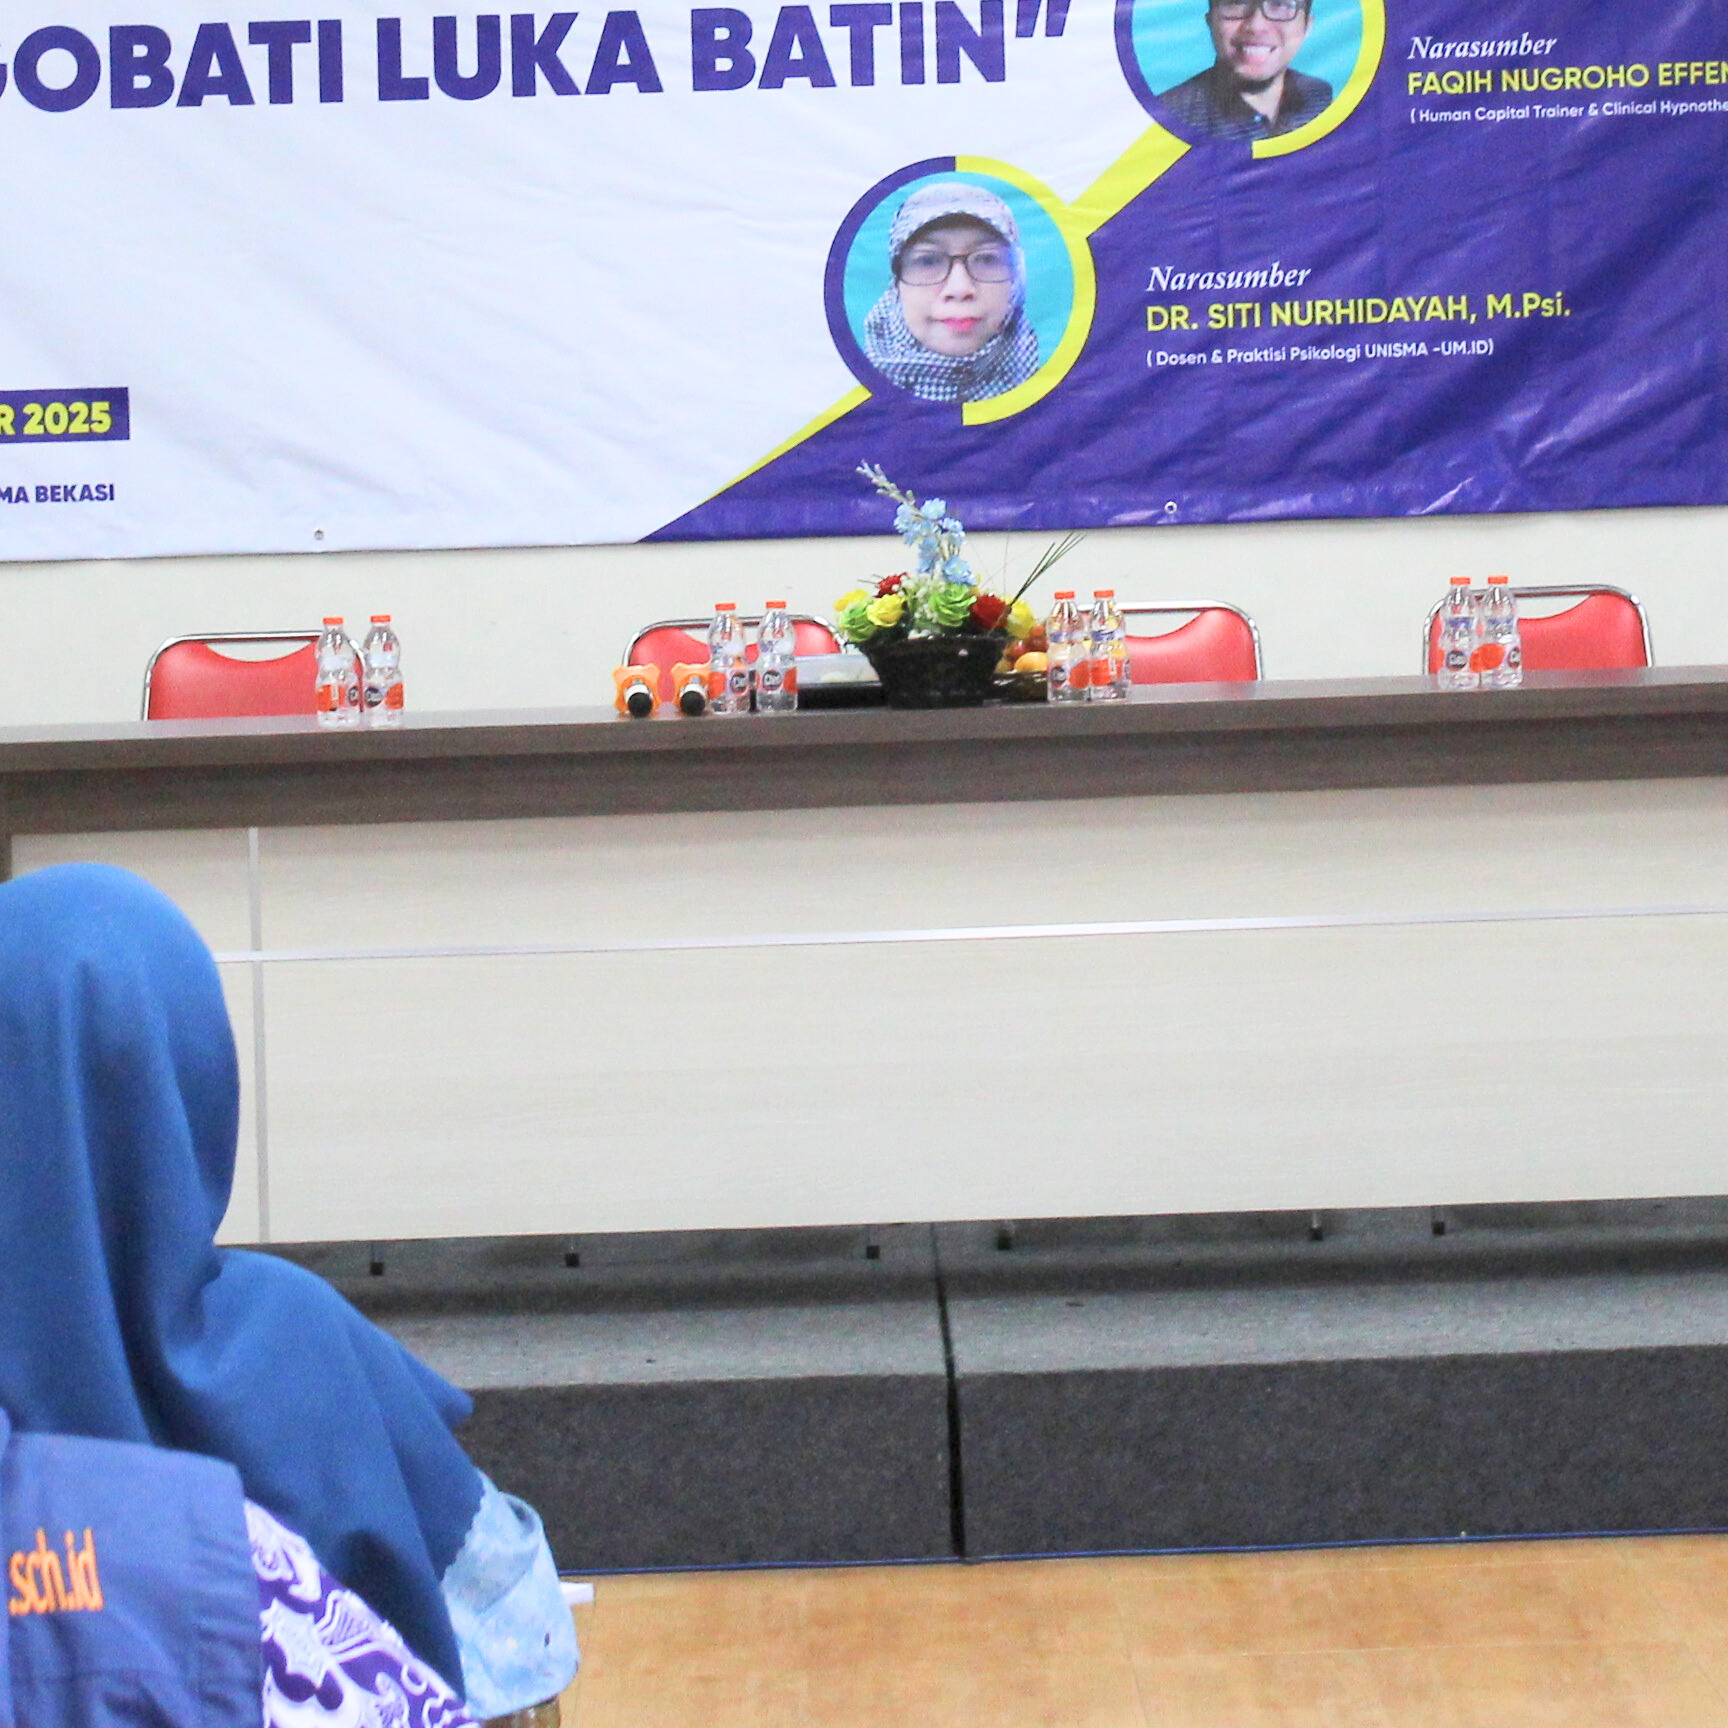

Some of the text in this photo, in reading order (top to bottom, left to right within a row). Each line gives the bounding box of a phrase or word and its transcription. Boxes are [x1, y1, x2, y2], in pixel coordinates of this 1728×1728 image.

[377, 11, 664, 101] LUKA
[1408, 36, 1557, 60] Narasumber
[1408, 71, 1493, 96] FAQIH
[1502, 65, 1649, 93] NUGROHO
[1420, 109, 1470, 122] Human
[1475, 106, 1529, 122] Capital
[1533, 104, 1583, 118] Trainer
[1588, 104, 1598, 116] &
[1602, 100, 1656, 115] Clinical
[1146, 262, 1311, 291] Narasumber
[1146, 292, 1571, 331] DR. SITI NURHIDAYAH, M.Psi.
[1156, 350, 1207, 365] Dosen
[1211, 350, 1223, 362] &
[1227, 346, 1285, 362] Praktisi
[1290, 344, 1361, 362] Psikologi
[1365, 342, 1428, 357] UNISMA
[23, 401, 112, 435] 2025
[36, 483, 115, 503] BEKASI
[9, 1528, 104, 1615] sch.id
